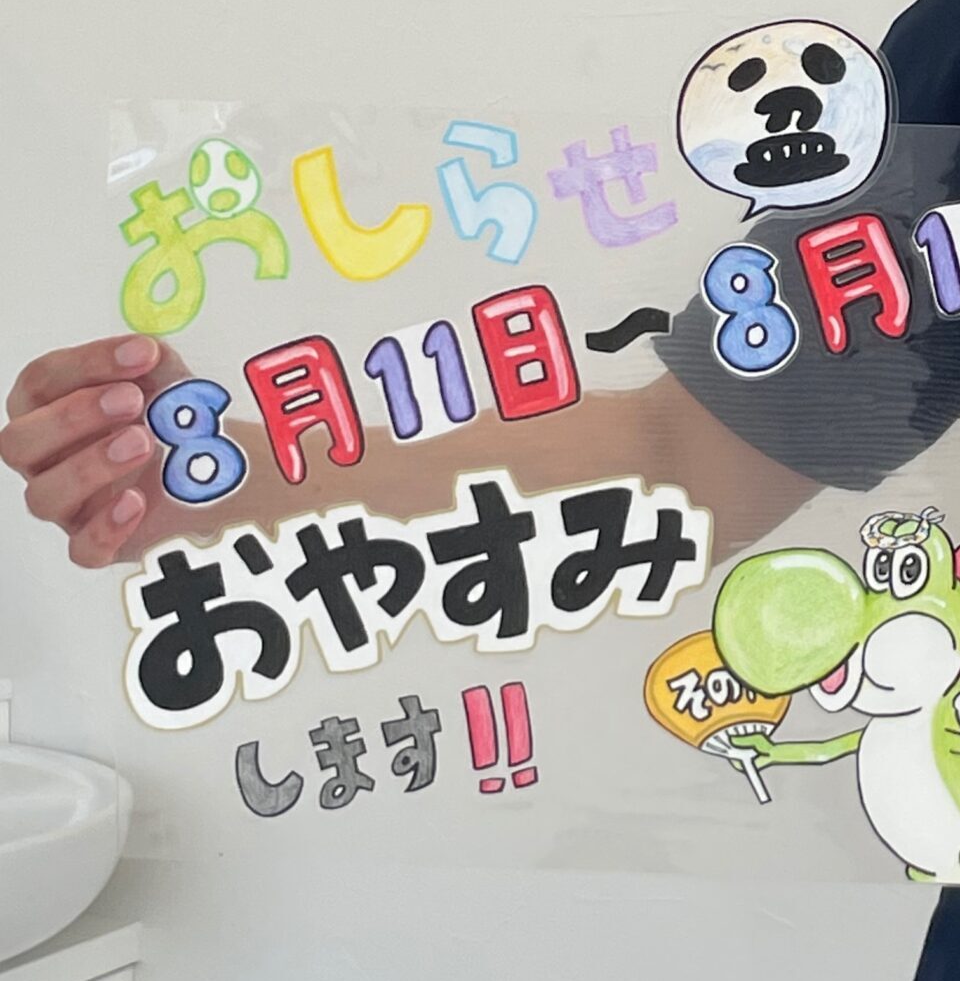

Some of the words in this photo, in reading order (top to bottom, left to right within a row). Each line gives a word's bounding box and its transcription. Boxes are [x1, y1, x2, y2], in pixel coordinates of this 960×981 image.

[119, 120, 679, 335] おしらせ
[136, 480, 697, 711] おやすみ
